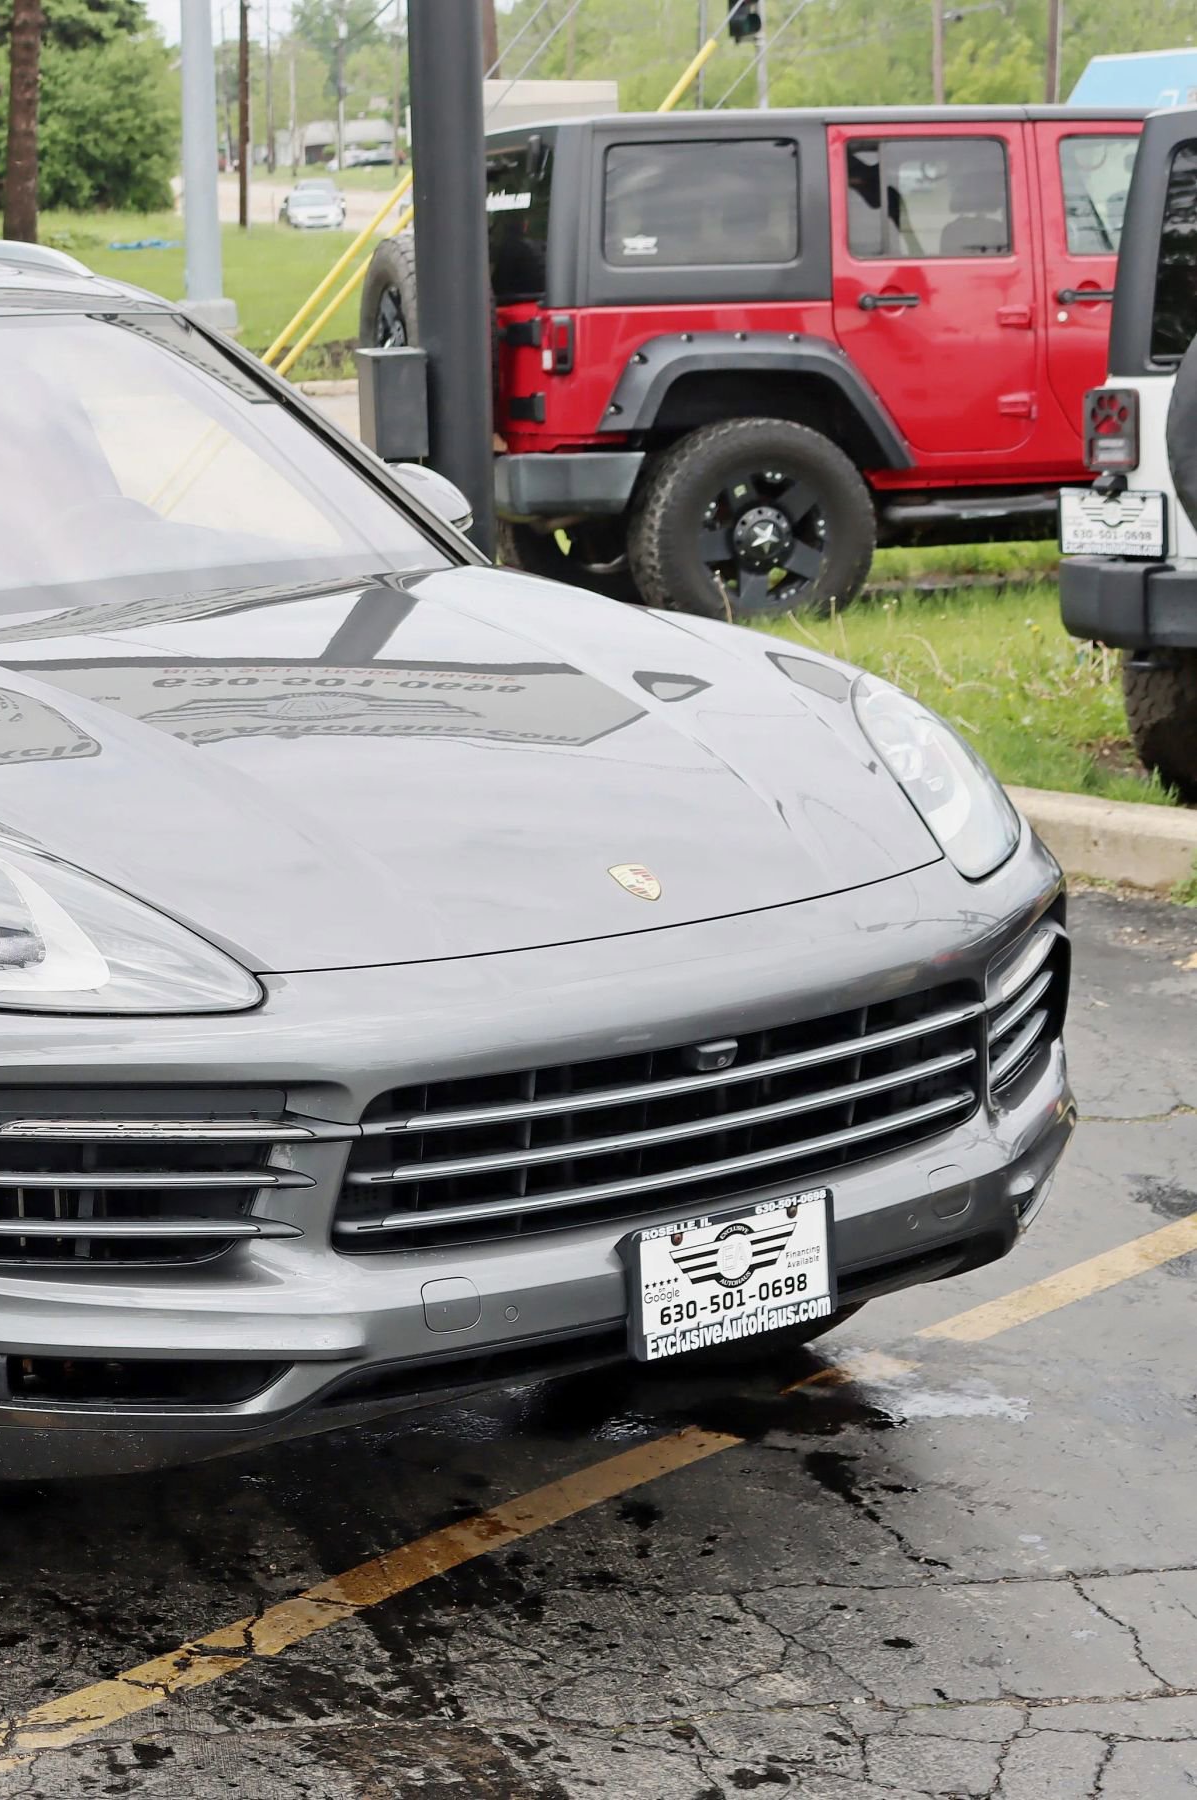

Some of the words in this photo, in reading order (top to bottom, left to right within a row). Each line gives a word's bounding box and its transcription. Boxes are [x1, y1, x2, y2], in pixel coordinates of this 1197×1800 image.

[755, 1189, 827, 1215] 630-501-0698
[699, 1217, 713, 1228] IL
[719, 1225, 750, 1240] EXCLUSIVE
[785, 1245, 821, 1259] Financing
[787, 1254, 820, 1269] Available
[719, 1271, 752, 1288] AUTOHAUS
[643, 1287, 681, 1304] Google
[660, 1273, 808, 1325] 630-501-0698
[646, 1295, 832, 1361] ExclusiveAutoHaus.com
